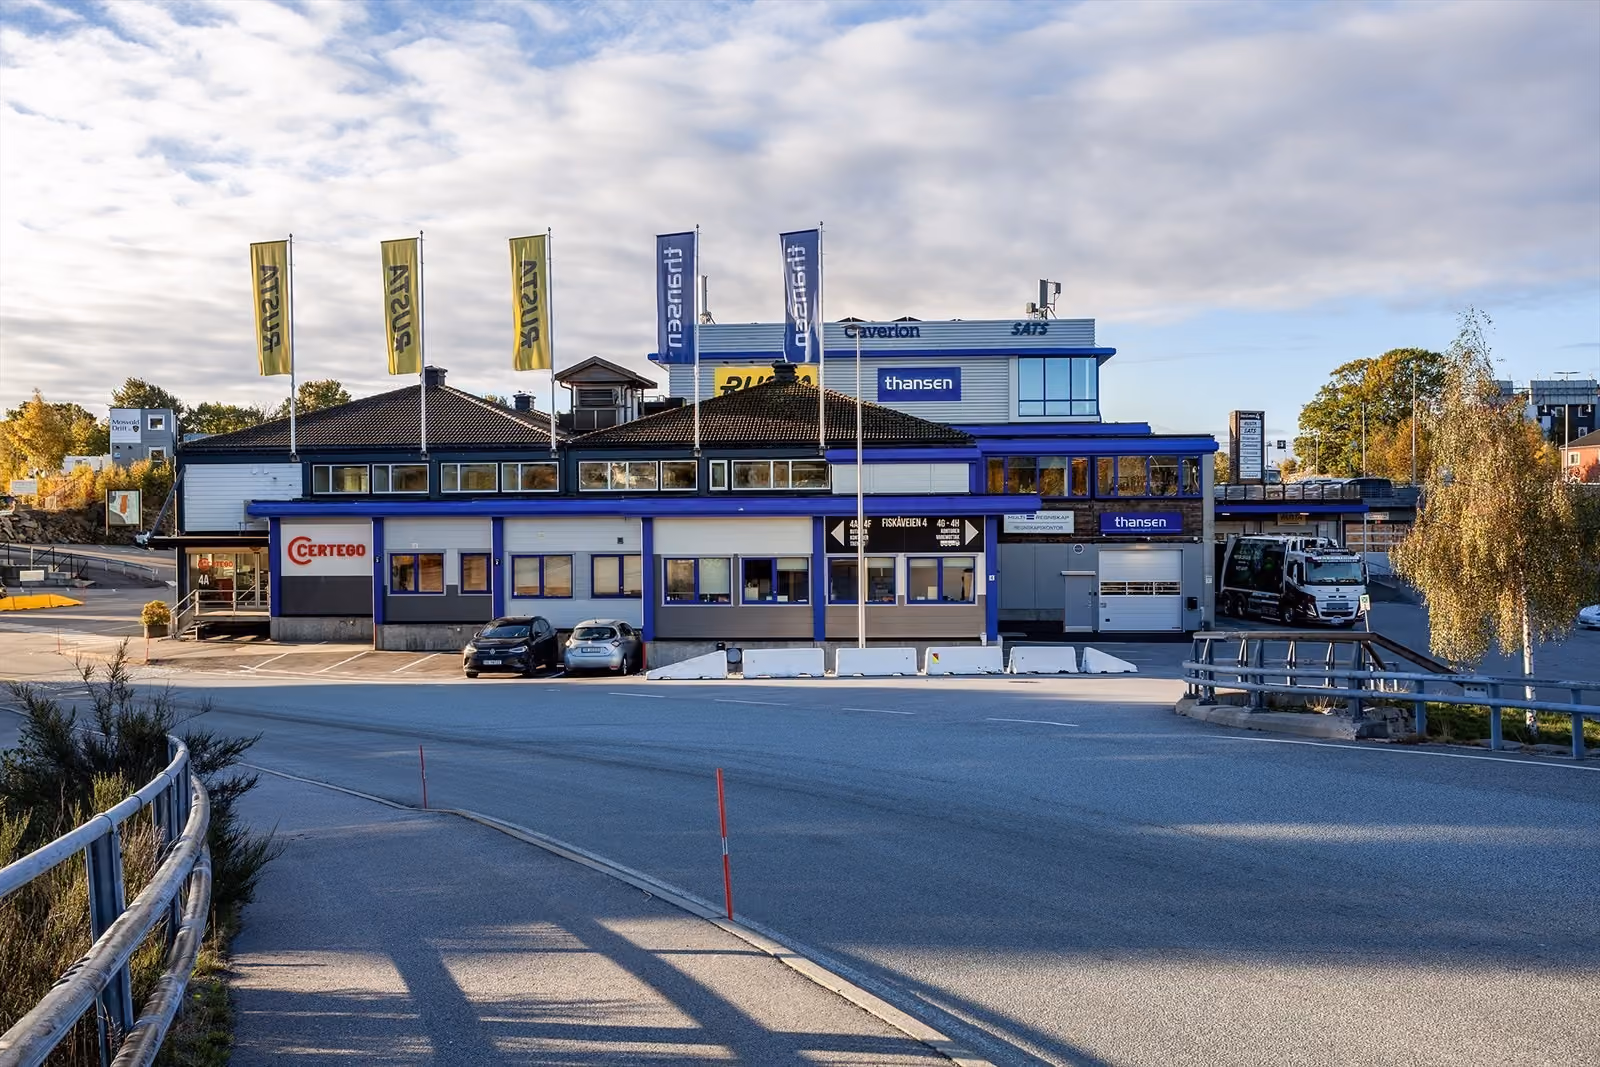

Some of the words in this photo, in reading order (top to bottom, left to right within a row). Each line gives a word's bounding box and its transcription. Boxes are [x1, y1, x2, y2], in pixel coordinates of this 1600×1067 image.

[1011, 322, 1049, 336] SATS
[884, 376, 953, 390] thansen
[881, 516, 921, 528] FISKÅVEIEN
[922, 518, 928, 528] 4
[936, 519, 946, 528] 4G
[950, 519, 960, 528] 4H
[1114, 516, 1167, 527] thansen
[198, 574, 209, 585] 4A
